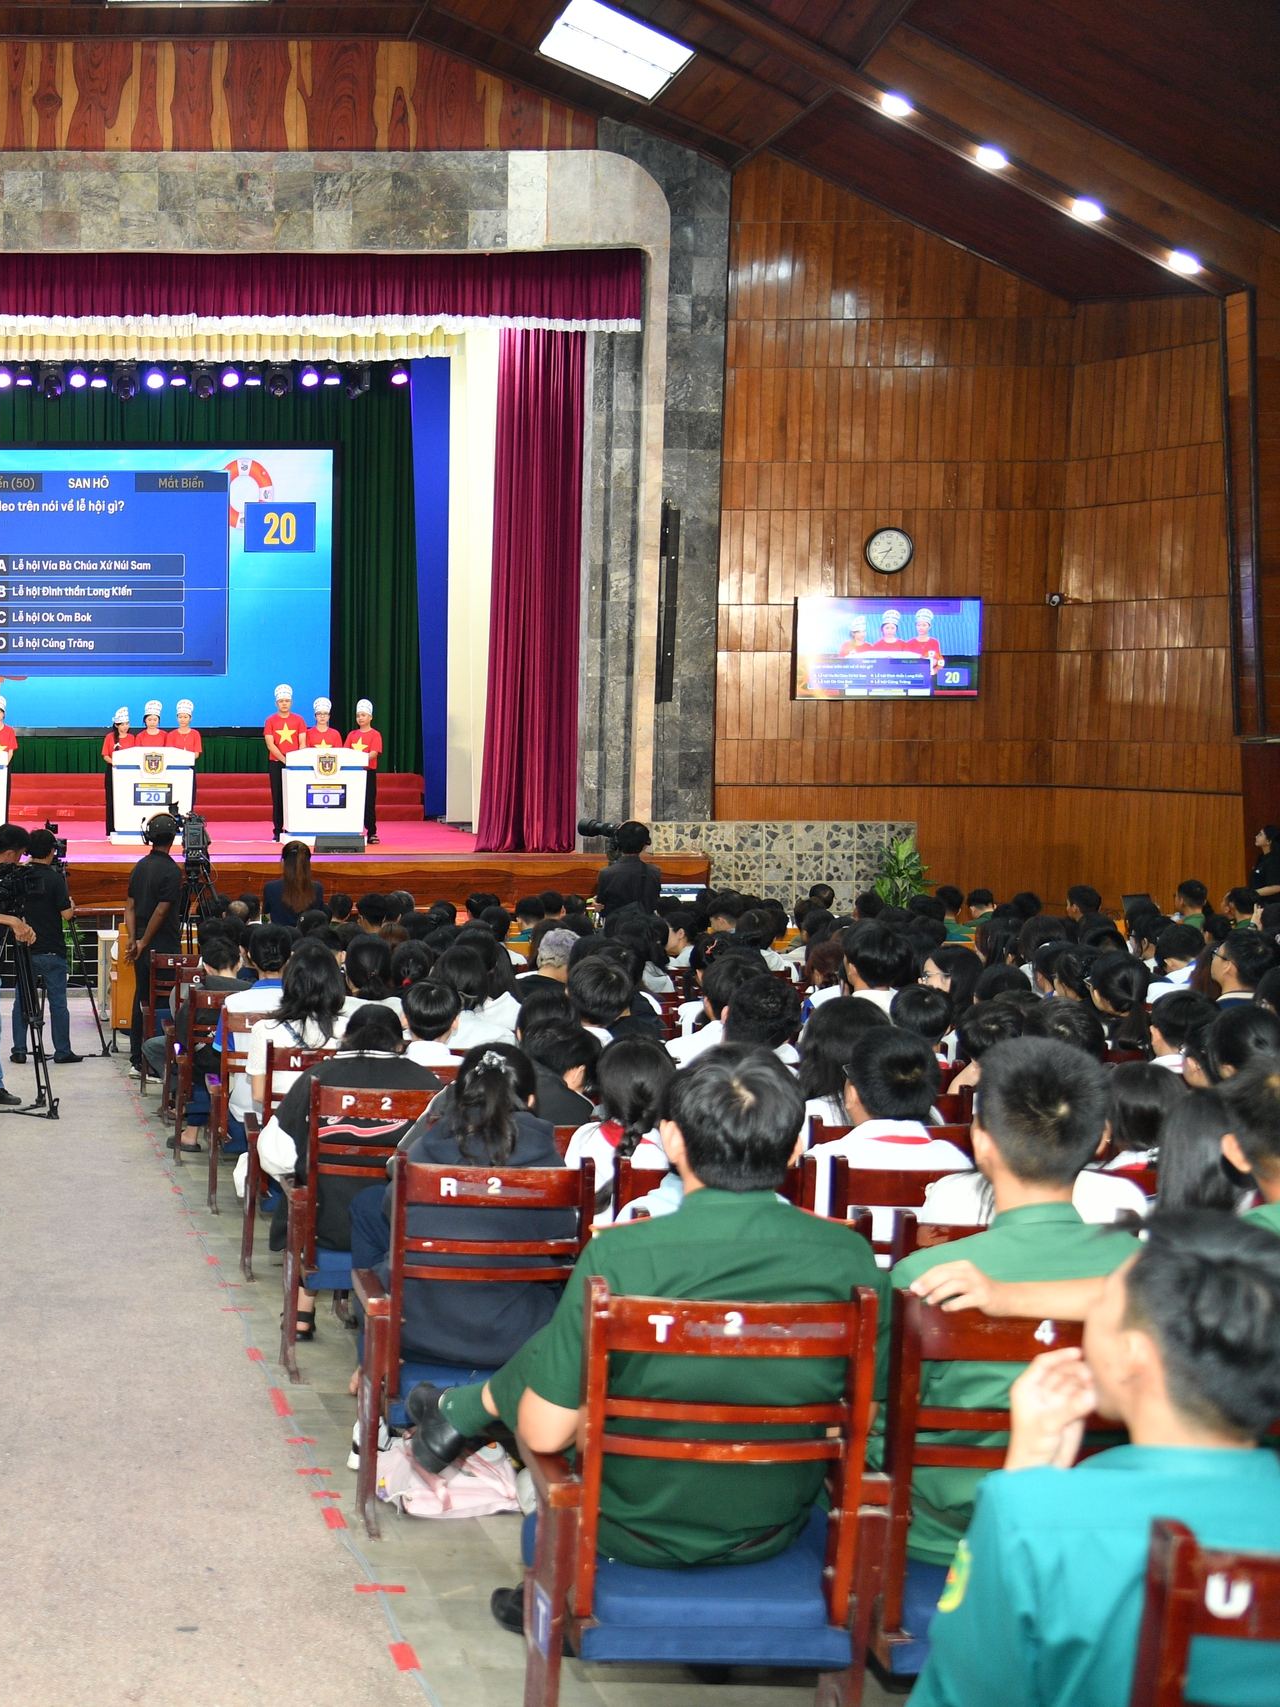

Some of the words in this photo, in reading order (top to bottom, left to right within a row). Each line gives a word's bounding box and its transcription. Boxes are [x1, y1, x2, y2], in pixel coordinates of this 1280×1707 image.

[11, 477, 35, 490] (50)
[68, 478, 90, 488] SAN
[93, 475, 110, 488] HÔ
[158, 476, 179, 488] Mắt
[182, 476, 204, 488] Biển
[18, 501, 39, 512] trên
[42, 500, 58, 512] nói
[61, 499, 74, 512] về
[77, 498, 85, 512] lễ
[89, 500, 105, 514] hội
[108, 500, 124, 514] gì?
[264, 512, 296, 545] 20
[13, 559, 23, 570] Lễ
[26, 560, 40, 572] hội
[42, 560, 58, 570] Vía
[59, 560, 71, 570] Bà
[74, 560, 98, 570] Chúa
[100, 560, 114, 570] Xứ
[114, 560, 128, 570] Núi
[131, 561, 151, 570] Sam
[13, 585, 23, 596] Lễ
[26, 586, 40, 598] hội
[87, 586, 110, 598] Long
[13, 611, 23, 622] Lễ
[26, 612, 40, 624] hội
[42, 613, 54, 622] Ok
[57, 613, 72, 622] Om
[74, 613, 92, 622] Bok
[13, 637, 23, 648] Lễ
[26, 638, 40, 650] hội
[42, 638, 66, 650] Cúng
[67, 638, 94, 650] Trăng
[945, 672, 960, 683] 20
[146, 792, 160, 802] 20
[323, 794, 330, 804] 0
[192, 975, 200, 983] G
[245, 1018, 252, 1028] L
[290, 1056, 302, 1068] N
[342, 1095, 355, 1109] P
[381, 1097, 392, 1110] 2
[440, 1177, 458, 1197] R
[487, 1176, 502, 1194] 2
[648, 1314, 675, 1343] T
[723, 1311, 743, 1336] 2
[1034, 1319, 1056, 1346] 4
[1204, 1572, 1252, 1620] U
[537, 1597, 546, 1642] T
